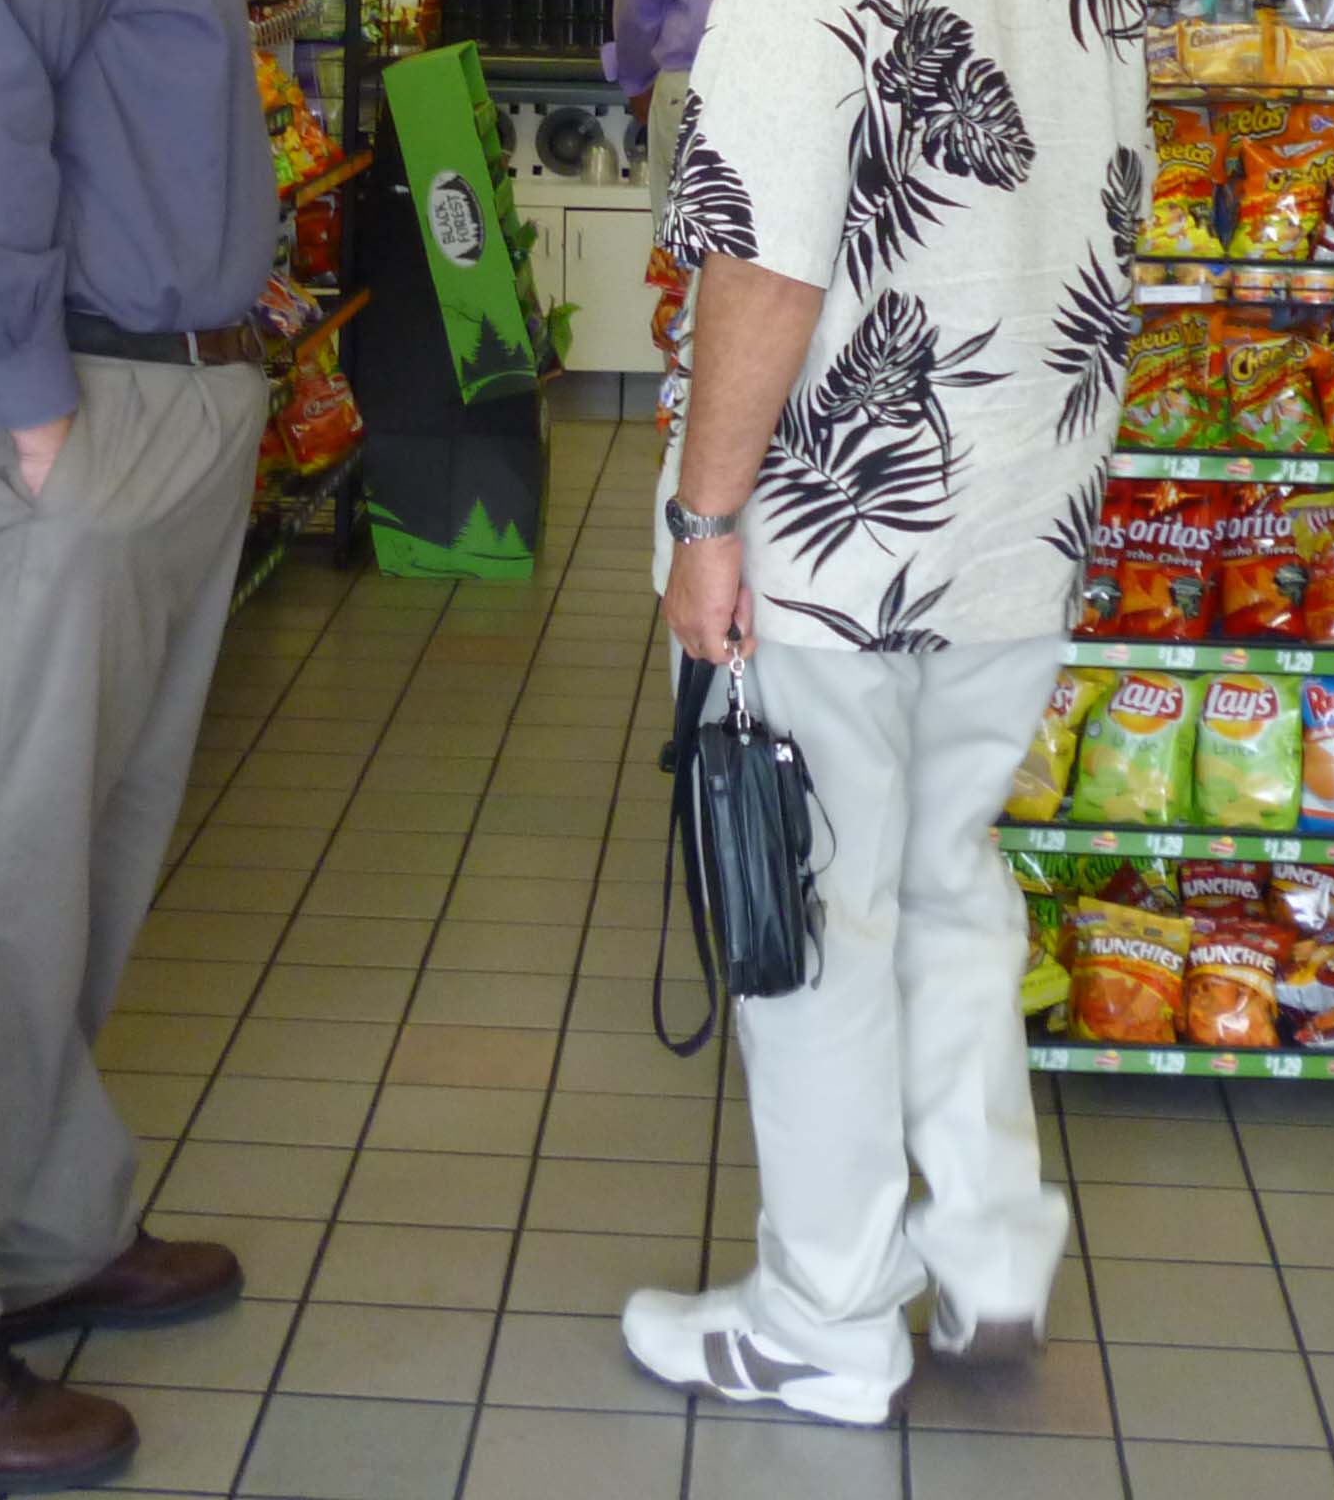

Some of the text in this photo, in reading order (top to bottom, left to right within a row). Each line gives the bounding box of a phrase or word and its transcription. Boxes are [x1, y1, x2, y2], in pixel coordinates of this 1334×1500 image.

[436, 200, 456, 245] BLACK
[447, 195, 470, 243] FOREST
[1128, 515, 1213, 550] oritos
[1205, 679, 1278, 719] Lay's
[1089, 937, 1184, 972] MUNCHIES
[1189, 944, 1276, 972] MUNCHIE
